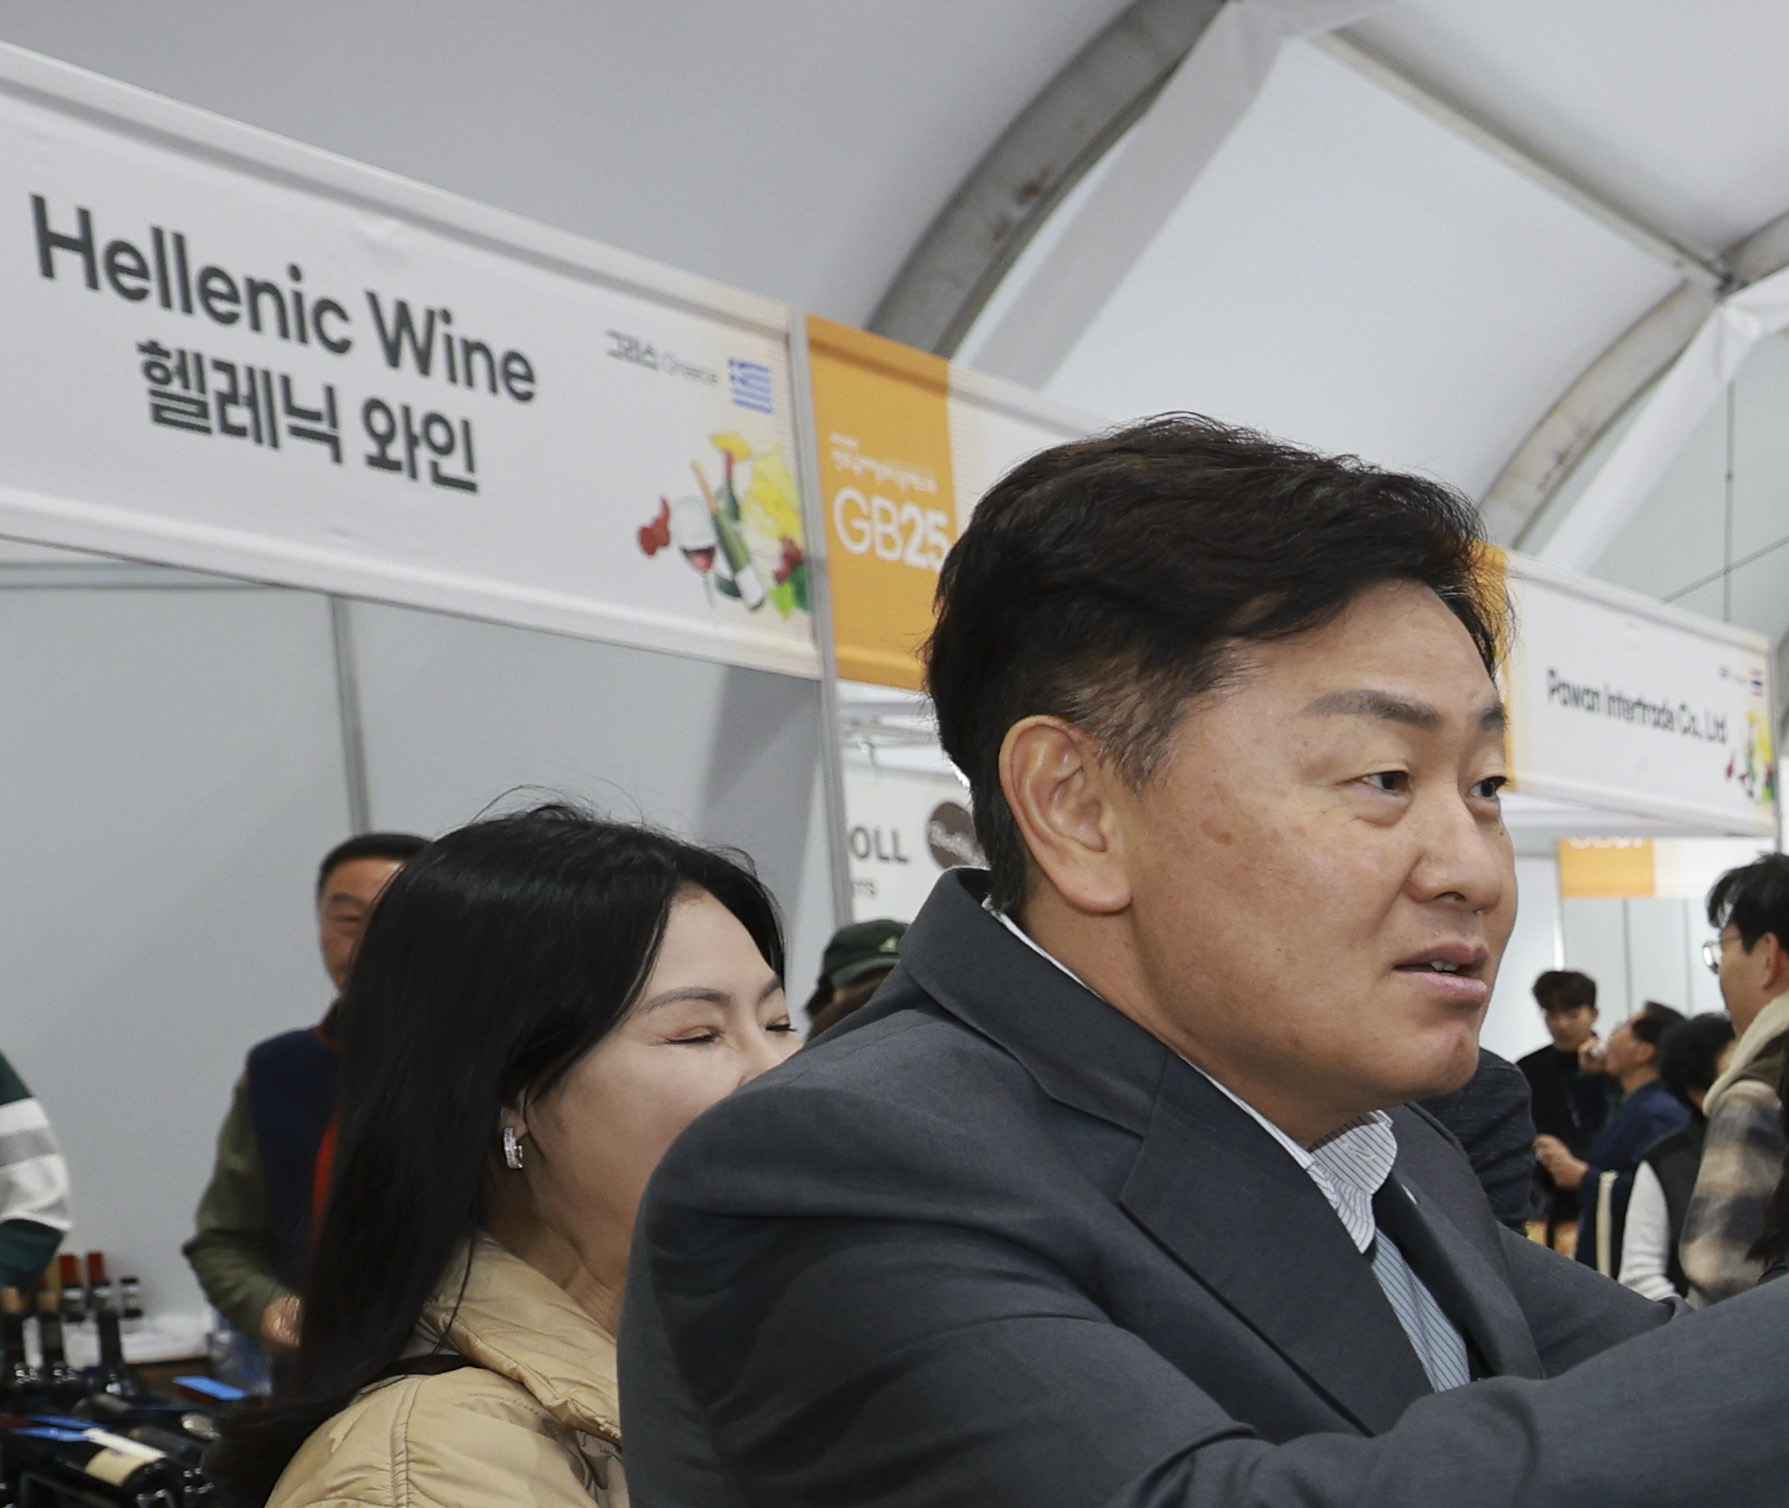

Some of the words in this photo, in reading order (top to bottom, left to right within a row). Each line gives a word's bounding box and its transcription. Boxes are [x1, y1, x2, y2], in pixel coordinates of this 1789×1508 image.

[29, 194, 353, 356] Hellenic
[365, 289, 538, 405] Wine
[136, 338, 344, 466] 헬레닉
[362, 396, 480, 495] 와인
